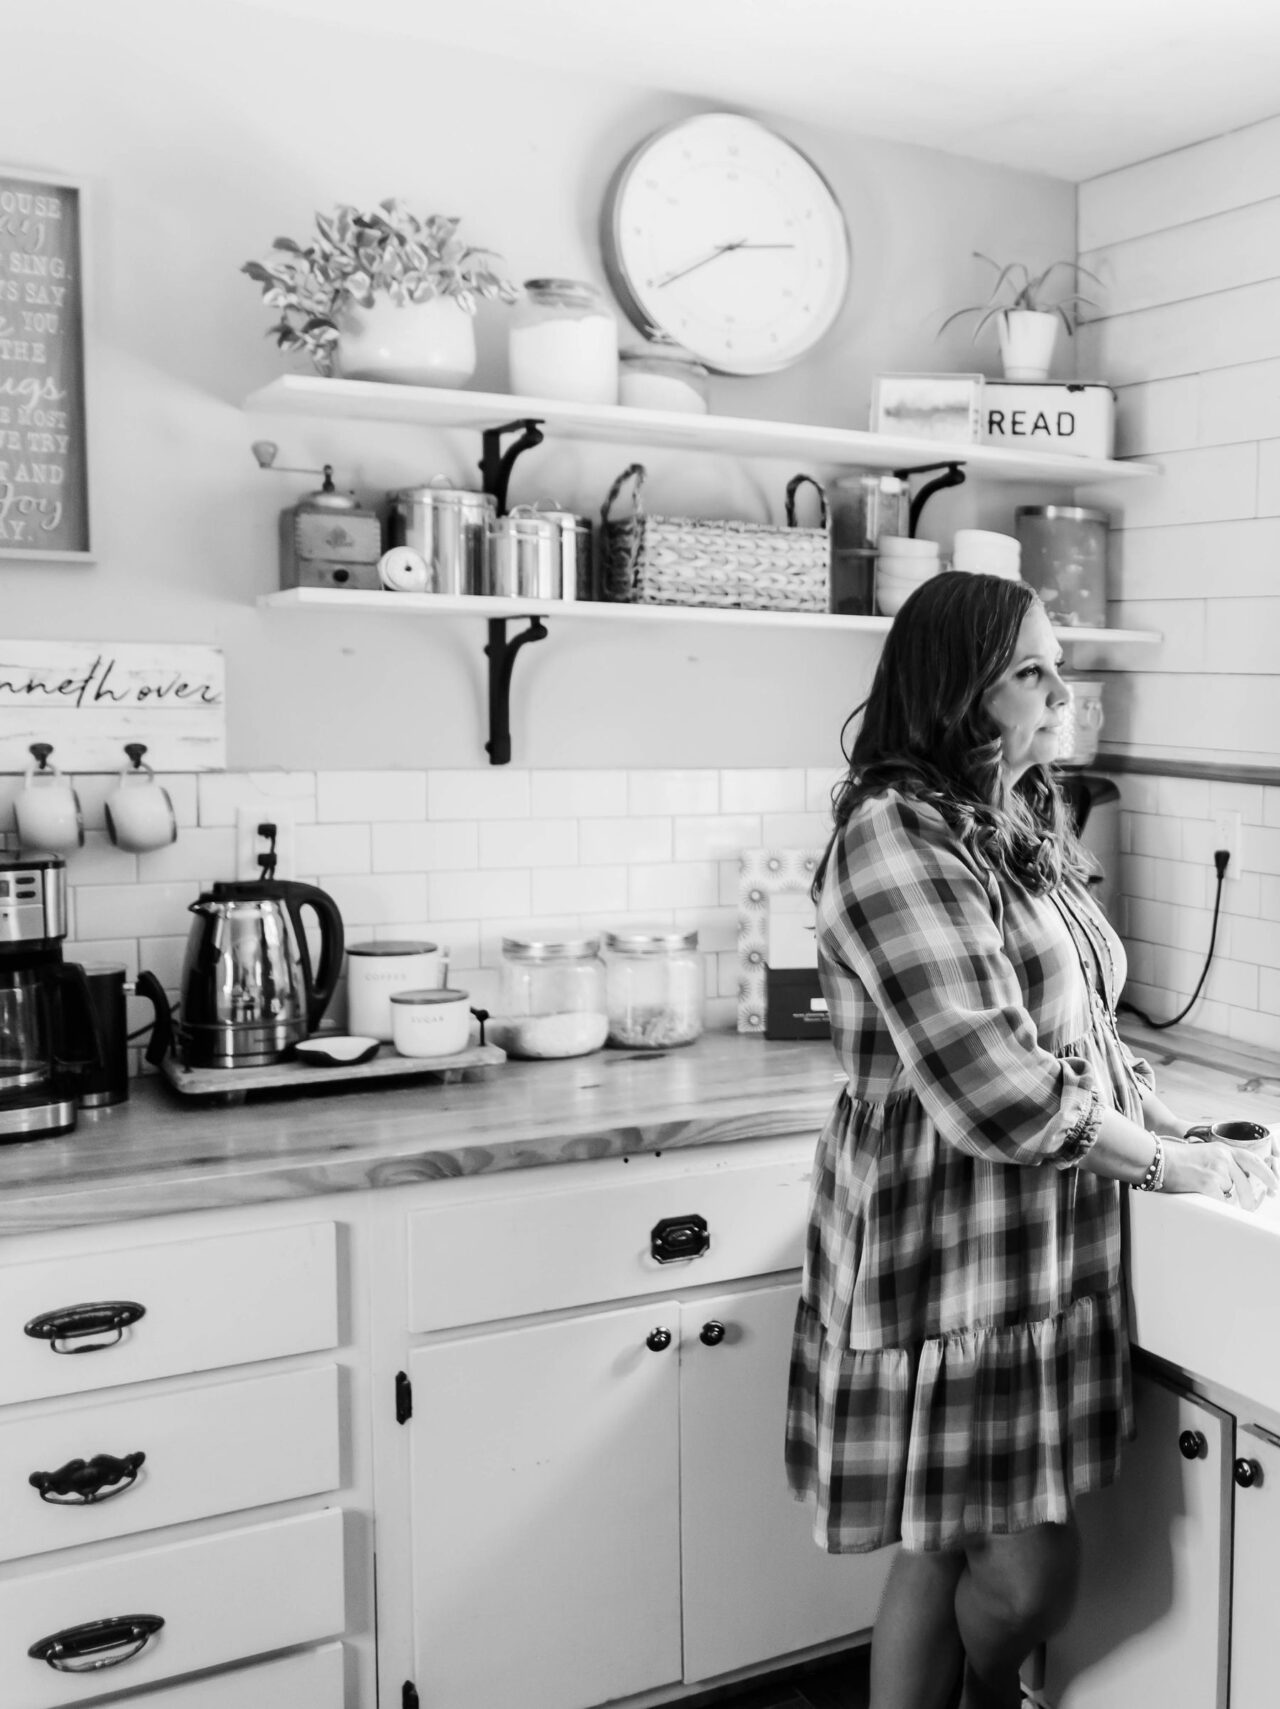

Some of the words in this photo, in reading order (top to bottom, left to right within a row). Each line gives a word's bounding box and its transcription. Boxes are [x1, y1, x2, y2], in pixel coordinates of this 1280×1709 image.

[0, 190, 62, 219] OUSE
[25, 282, 66, 307] SAY
[17, 406, 66, 429] MOST
[988, 410, 1075, 437] READ
[27, 431, 70, 454] TRY
[14, 463, 64, 485] AND
[0, 519, 33, 541] AY.
[0, 654, 130, 708] nneth
[137, 672, 222, 703] over
